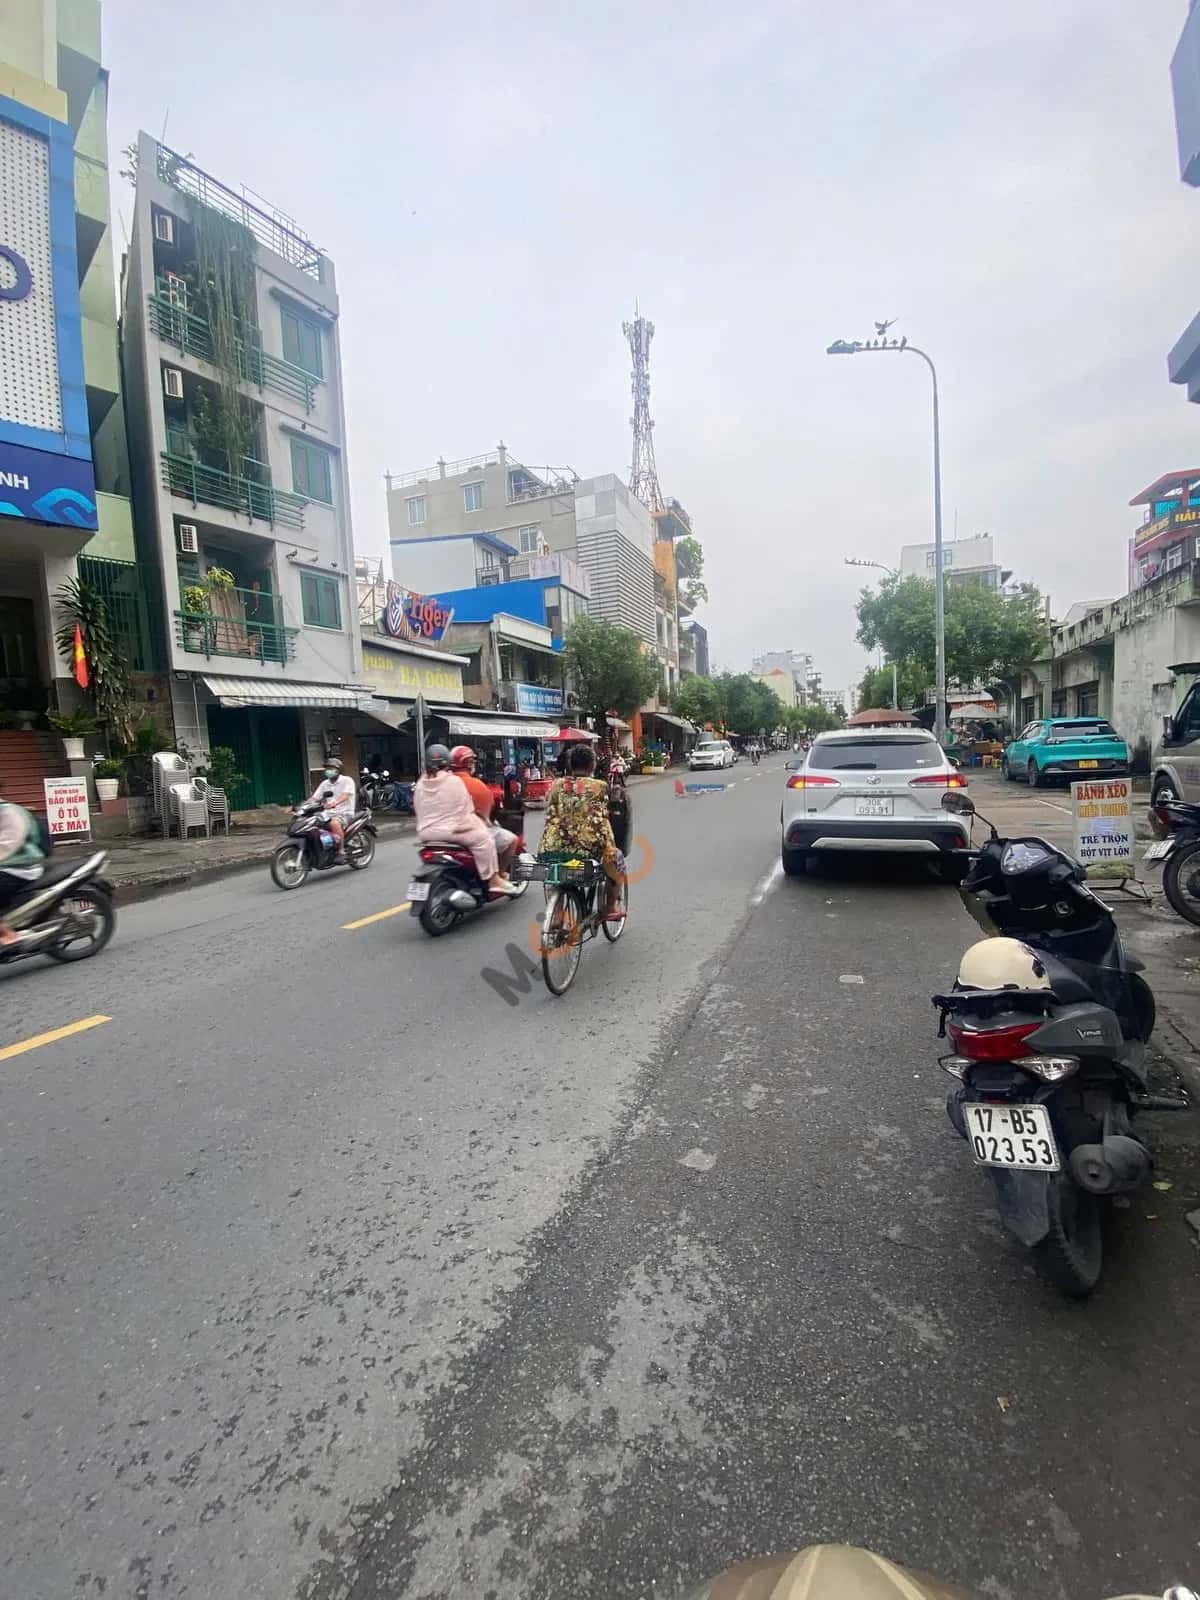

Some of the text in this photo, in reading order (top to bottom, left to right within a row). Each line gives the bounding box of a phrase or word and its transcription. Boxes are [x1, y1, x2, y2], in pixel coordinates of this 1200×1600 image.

[407, 591, 450, 637] Tiger
[67, 805, 79, 818] TÔ
[52, 819, 87, 832] XE MÁY
[974, 1135, 1053, 1165] 023.53
